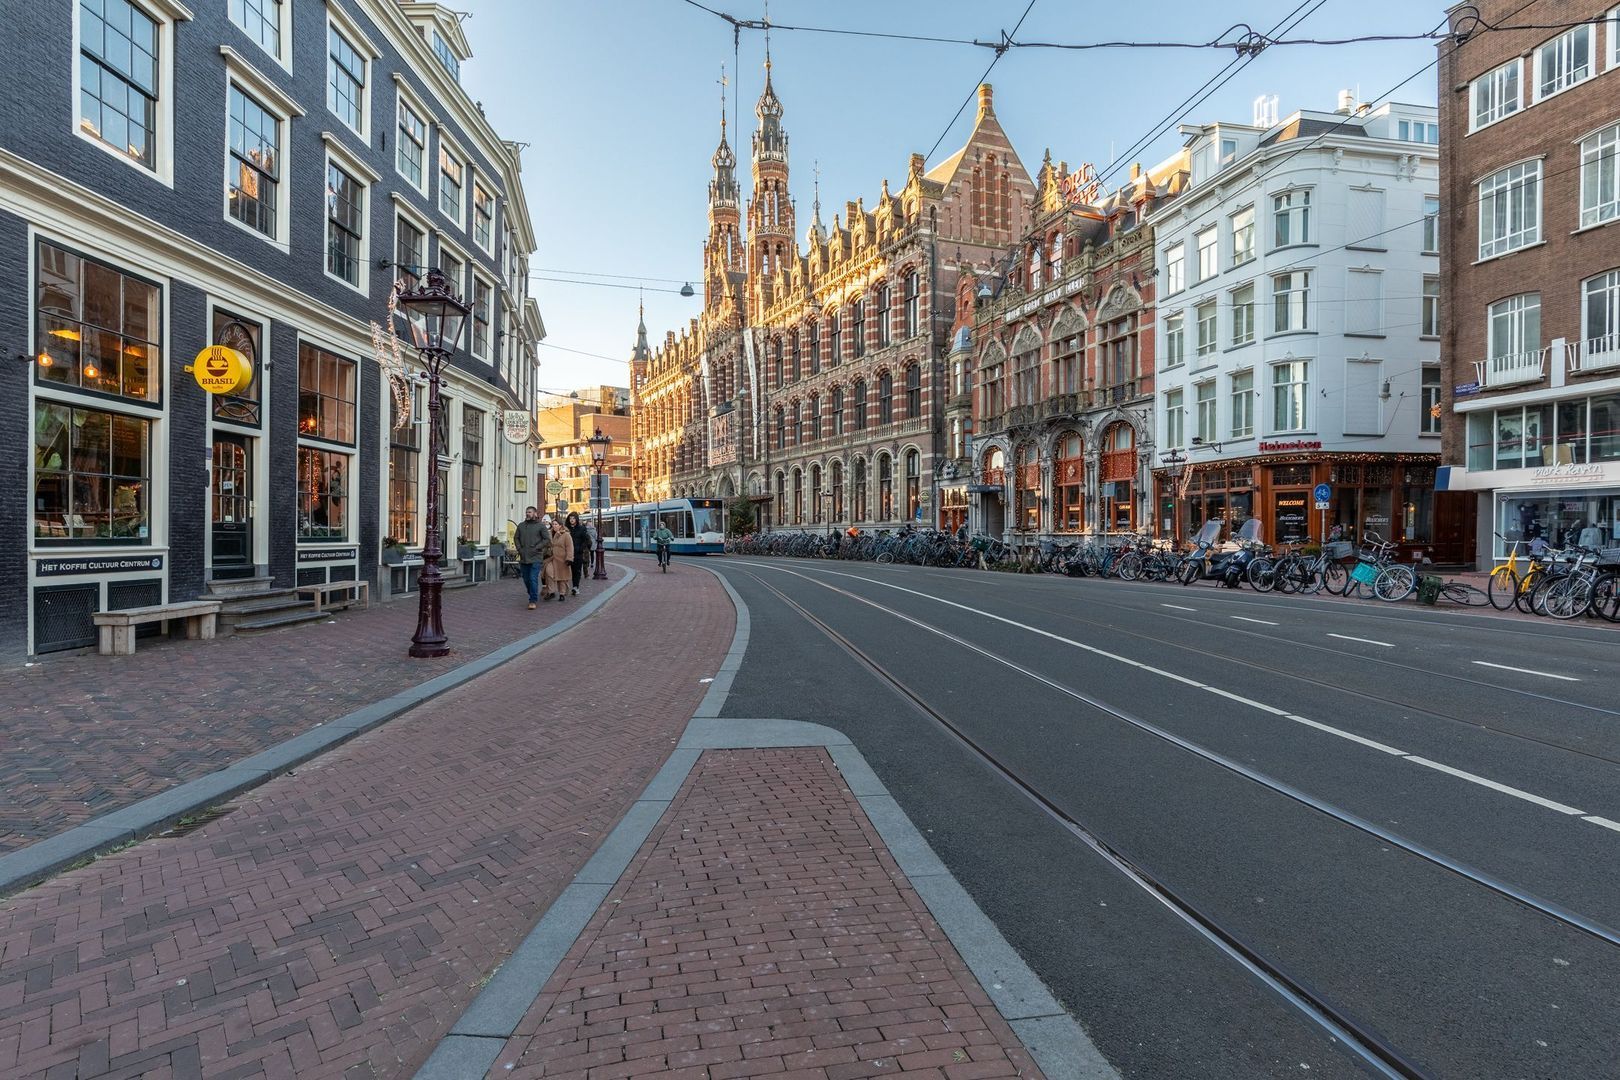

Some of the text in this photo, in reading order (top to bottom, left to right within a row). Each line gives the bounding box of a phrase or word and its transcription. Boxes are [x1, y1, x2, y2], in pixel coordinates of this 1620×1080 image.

[1259, 440, 1322, 451] Heineken
[41, 560, 150, 572] HET KOFFIE CULTUUR CENTRUM
